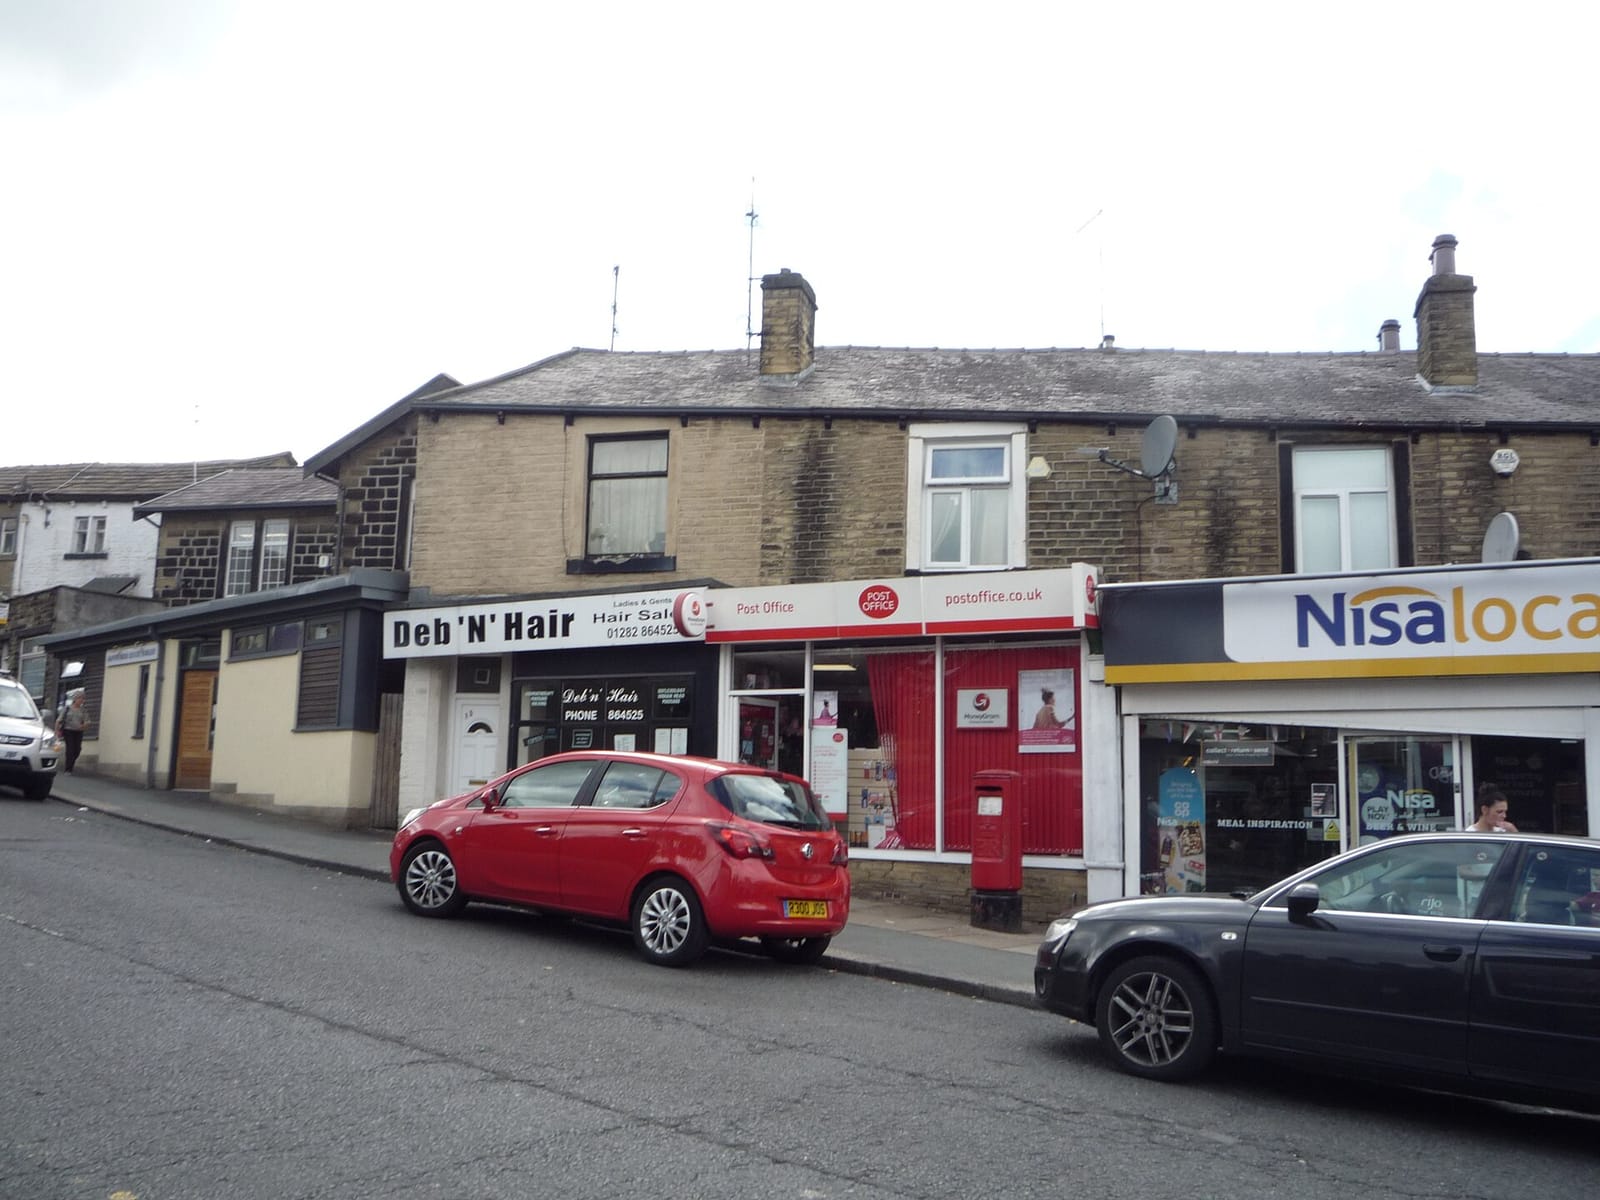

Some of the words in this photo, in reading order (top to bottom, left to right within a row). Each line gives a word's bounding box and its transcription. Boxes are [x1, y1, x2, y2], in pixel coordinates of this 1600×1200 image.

[613, 600, 638, 608] Ladies
[649, 597, 672, 605] Gents
[866, 591, 892, 601] POST
[945, 588, 1042, 607] postoffice.co.uk
[737, 603, 760, 614] Post
[763, 601, 794, 613] Office
[862, 600, 895, 612] OFFICE
[592, 611, 632, 624] Hair
[393, 617, 451, 648] Deb
[504, 609, 575, 641] Hair
[607, 626, 638, 639] 01282
[606, 687, 639, 703] Hair
[565, 709, 598, 721] PHONE
[608, 709, 644, 721] 864525
[1387, 789, 1435, 808] Nisa
[1217, 818, 1245, 828] MEAL
[1247, 819, 1314, 829] INSPIRATION
[1407, 823, 1437, 832] WINE
